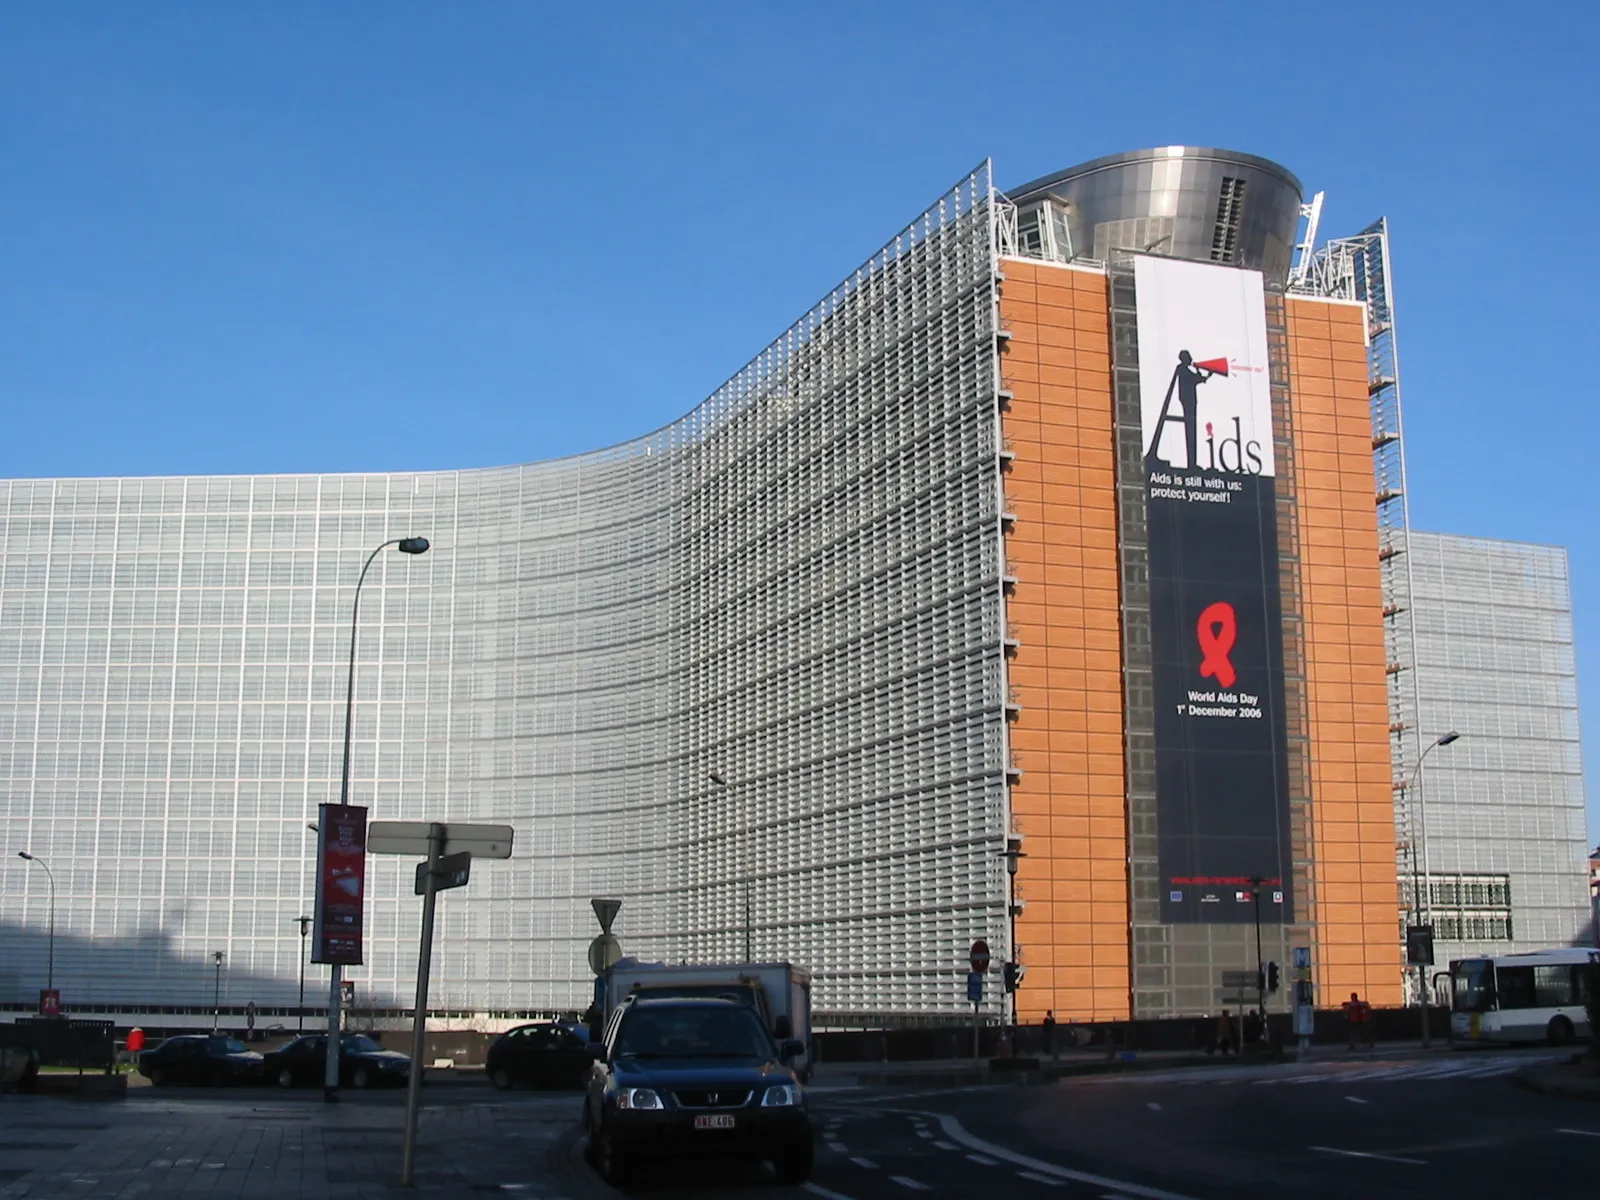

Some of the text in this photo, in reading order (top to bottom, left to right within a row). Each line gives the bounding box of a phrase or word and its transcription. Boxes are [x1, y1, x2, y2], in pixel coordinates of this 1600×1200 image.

[1144, 350, 1262, 475] Aids
[1150, 472, 1242, 491] Aids is still with us:
[1150, 488, 1231, 503] protect yourself!
[1187, 691, 1259, 706] World Aids Day
[1188, 705, 1237, 717] December
[1239, 708, 1262, 719] 2006
